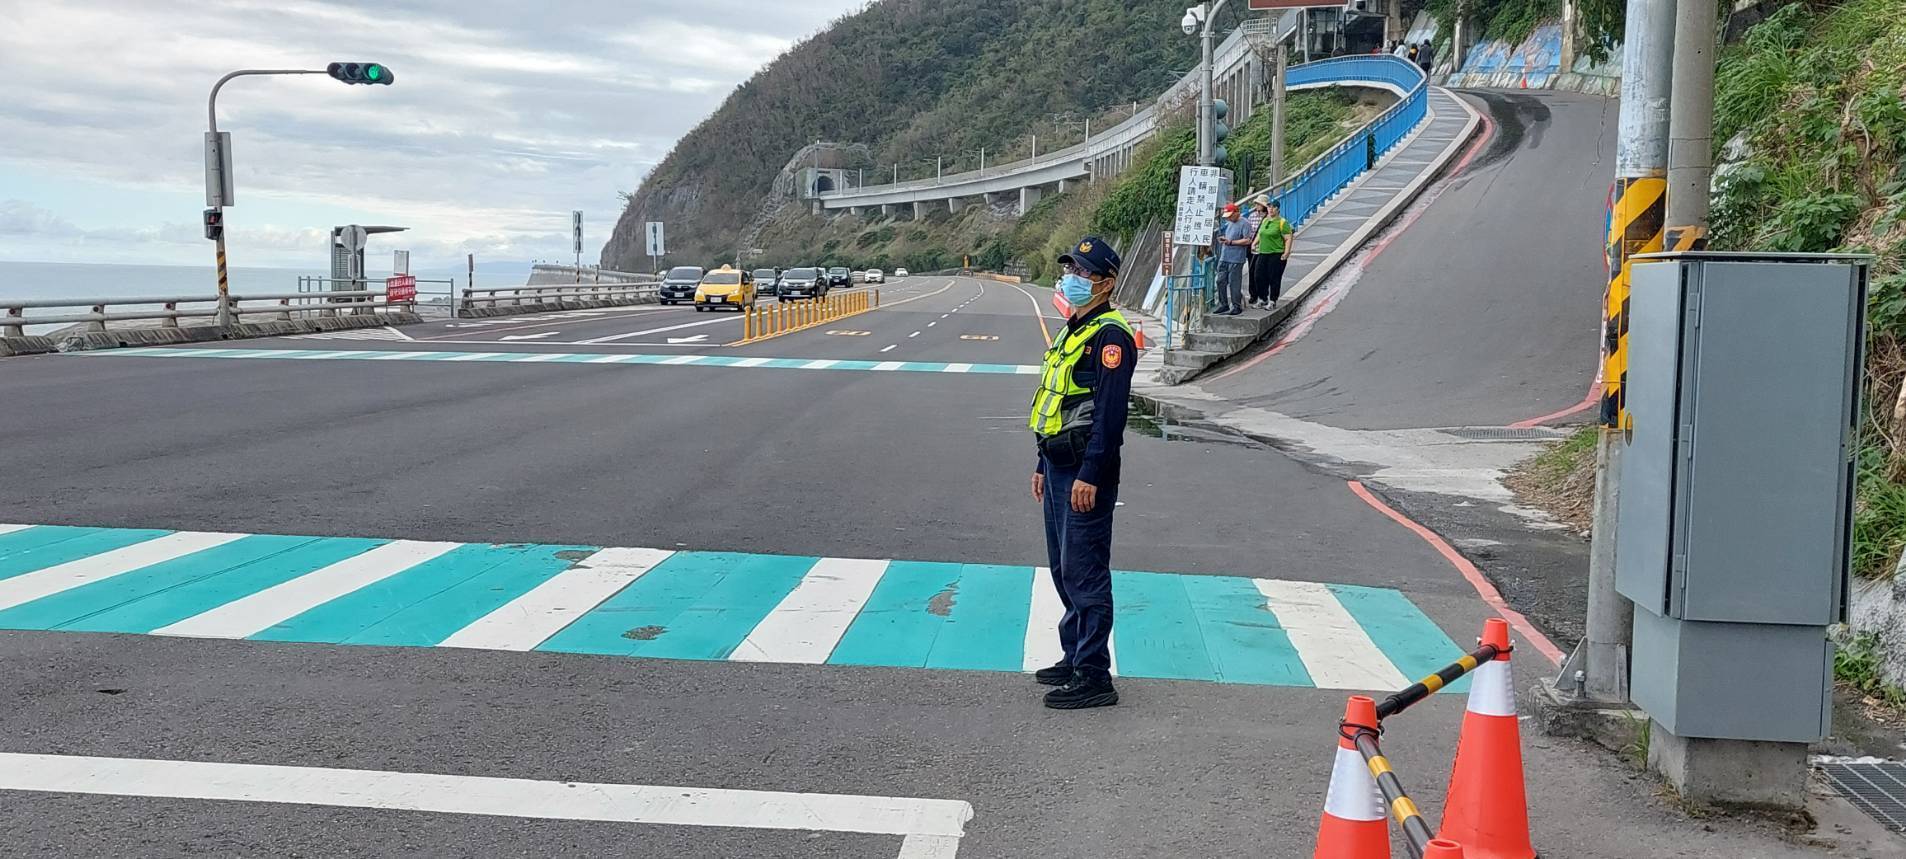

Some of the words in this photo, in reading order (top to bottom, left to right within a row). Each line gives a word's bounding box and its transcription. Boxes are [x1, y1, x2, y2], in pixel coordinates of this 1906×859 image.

[1192, 168, 1208, 243] 車輛禁止進入
